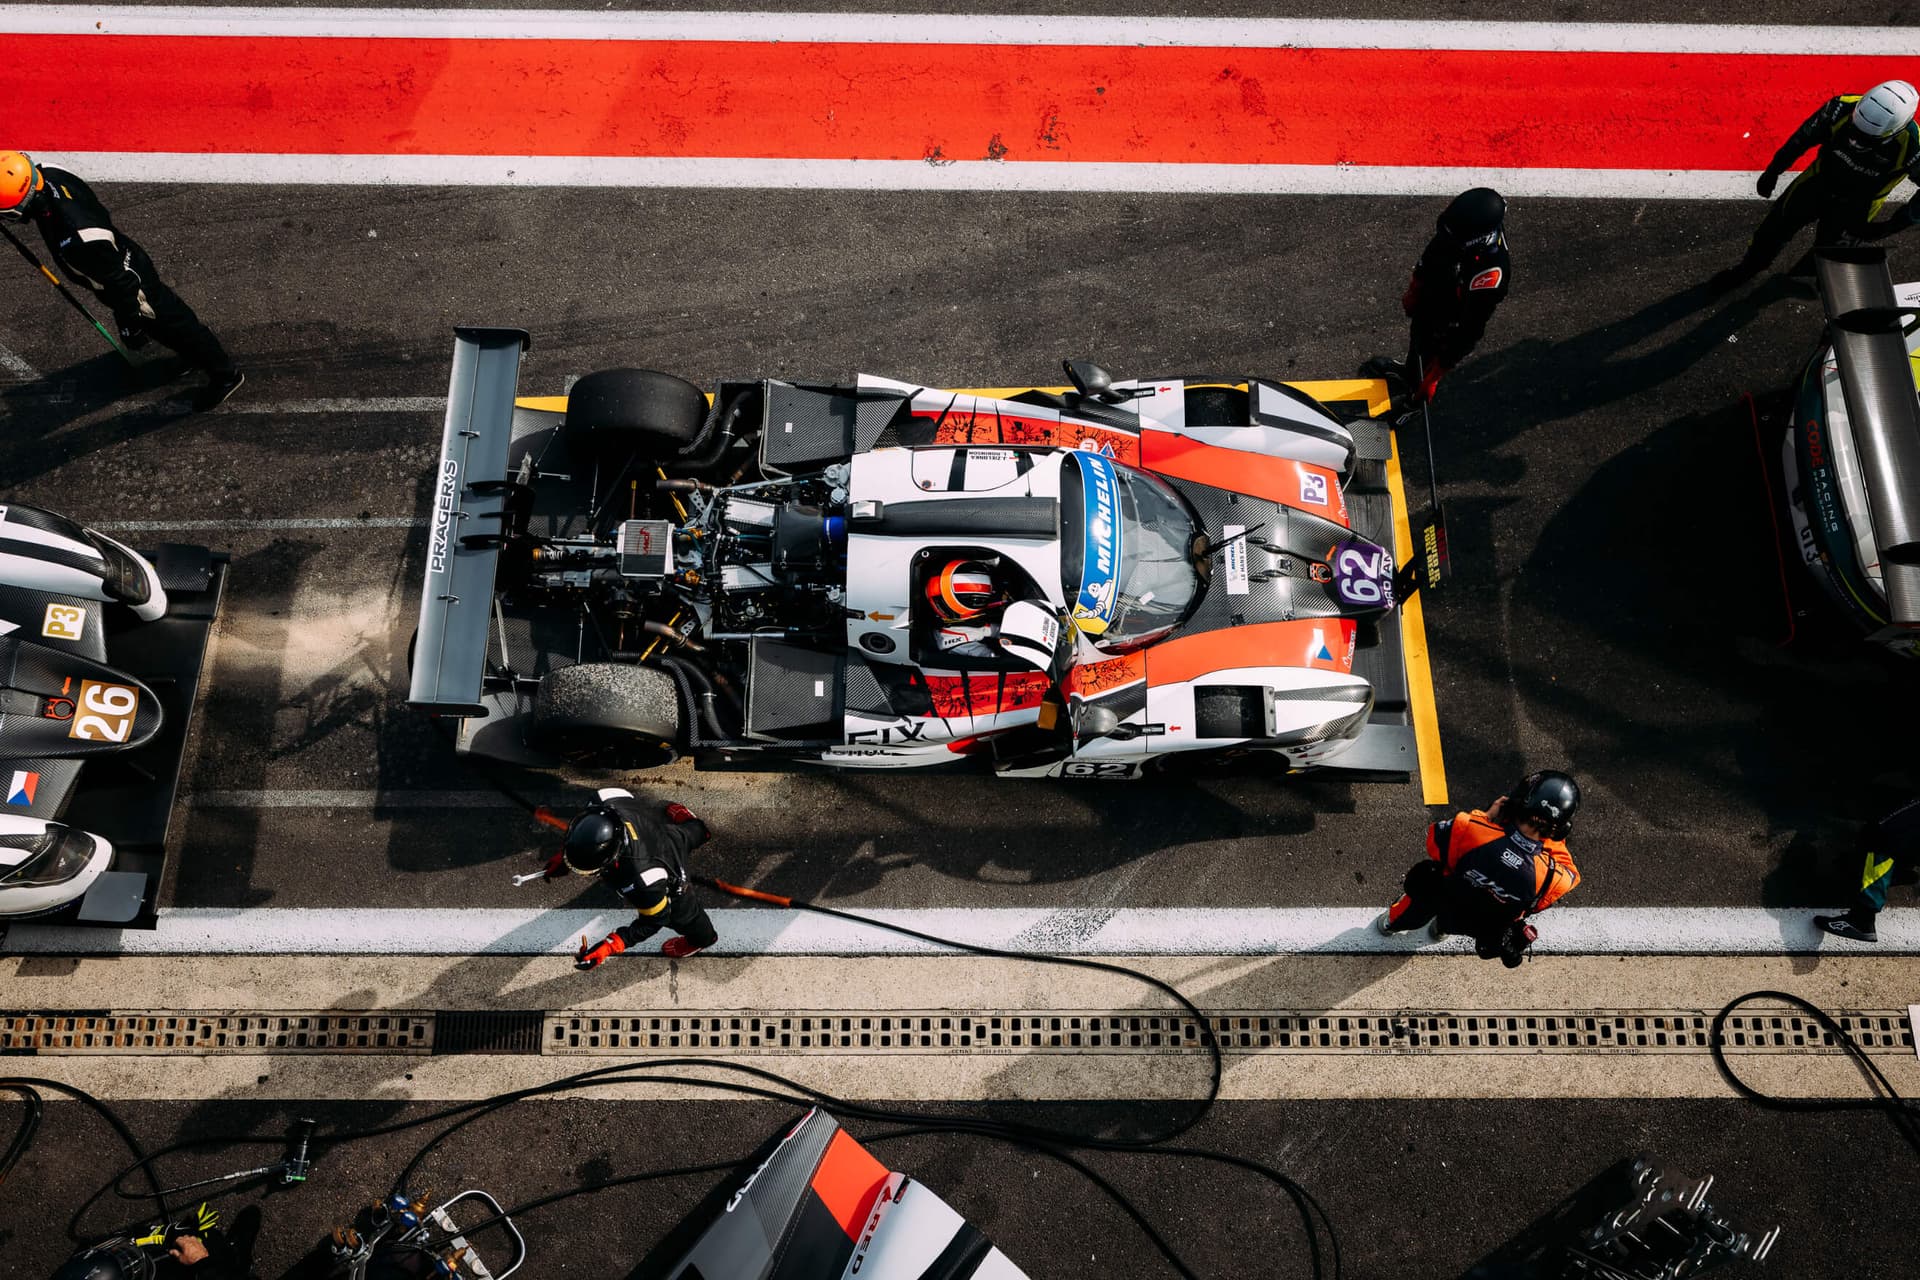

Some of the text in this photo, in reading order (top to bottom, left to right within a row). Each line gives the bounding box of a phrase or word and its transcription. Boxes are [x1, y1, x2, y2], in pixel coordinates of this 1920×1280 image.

[1303, 474, 1325, 503] P3
[1087, 457, 1112, 575] MICHELIN
[1340, 549, 1380, 602] 62
[1383, 580, 1394, 608] PRO
[46, 607, 79, 638] P3
[75, 684, 136, 742] 26
[1066, 763, 1128, 776] 62
[1503, 850, 1522, 866] OMP
